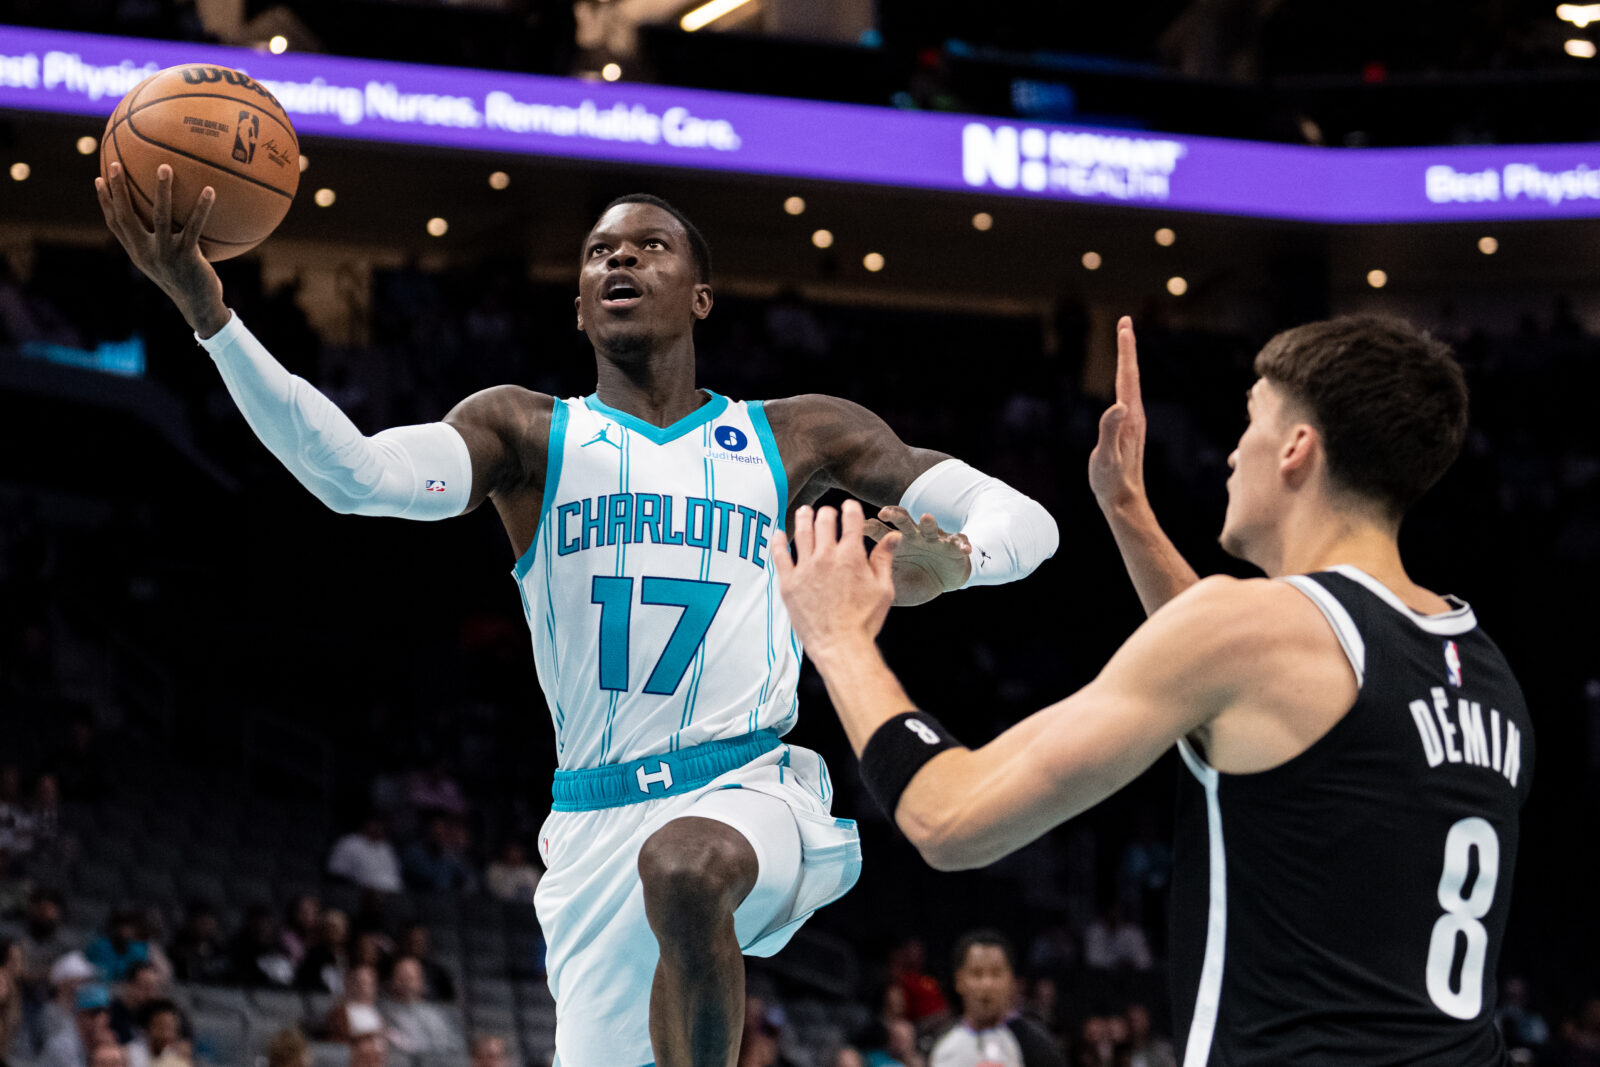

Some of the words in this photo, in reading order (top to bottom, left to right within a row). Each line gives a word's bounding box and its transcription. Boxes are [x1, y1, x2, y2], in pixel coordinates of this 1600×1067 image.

[0, 55, 39, 88] est
[486, 92, 661, 143] Remarkable
[1425, 165, 1500, 203] Best
[556, 492, 772, 570] CHARLOTTE
[591, 575, 731, 696] 17
[903, 718, 941, 745] 8
[1425, 816, 1500, 1021] 8
